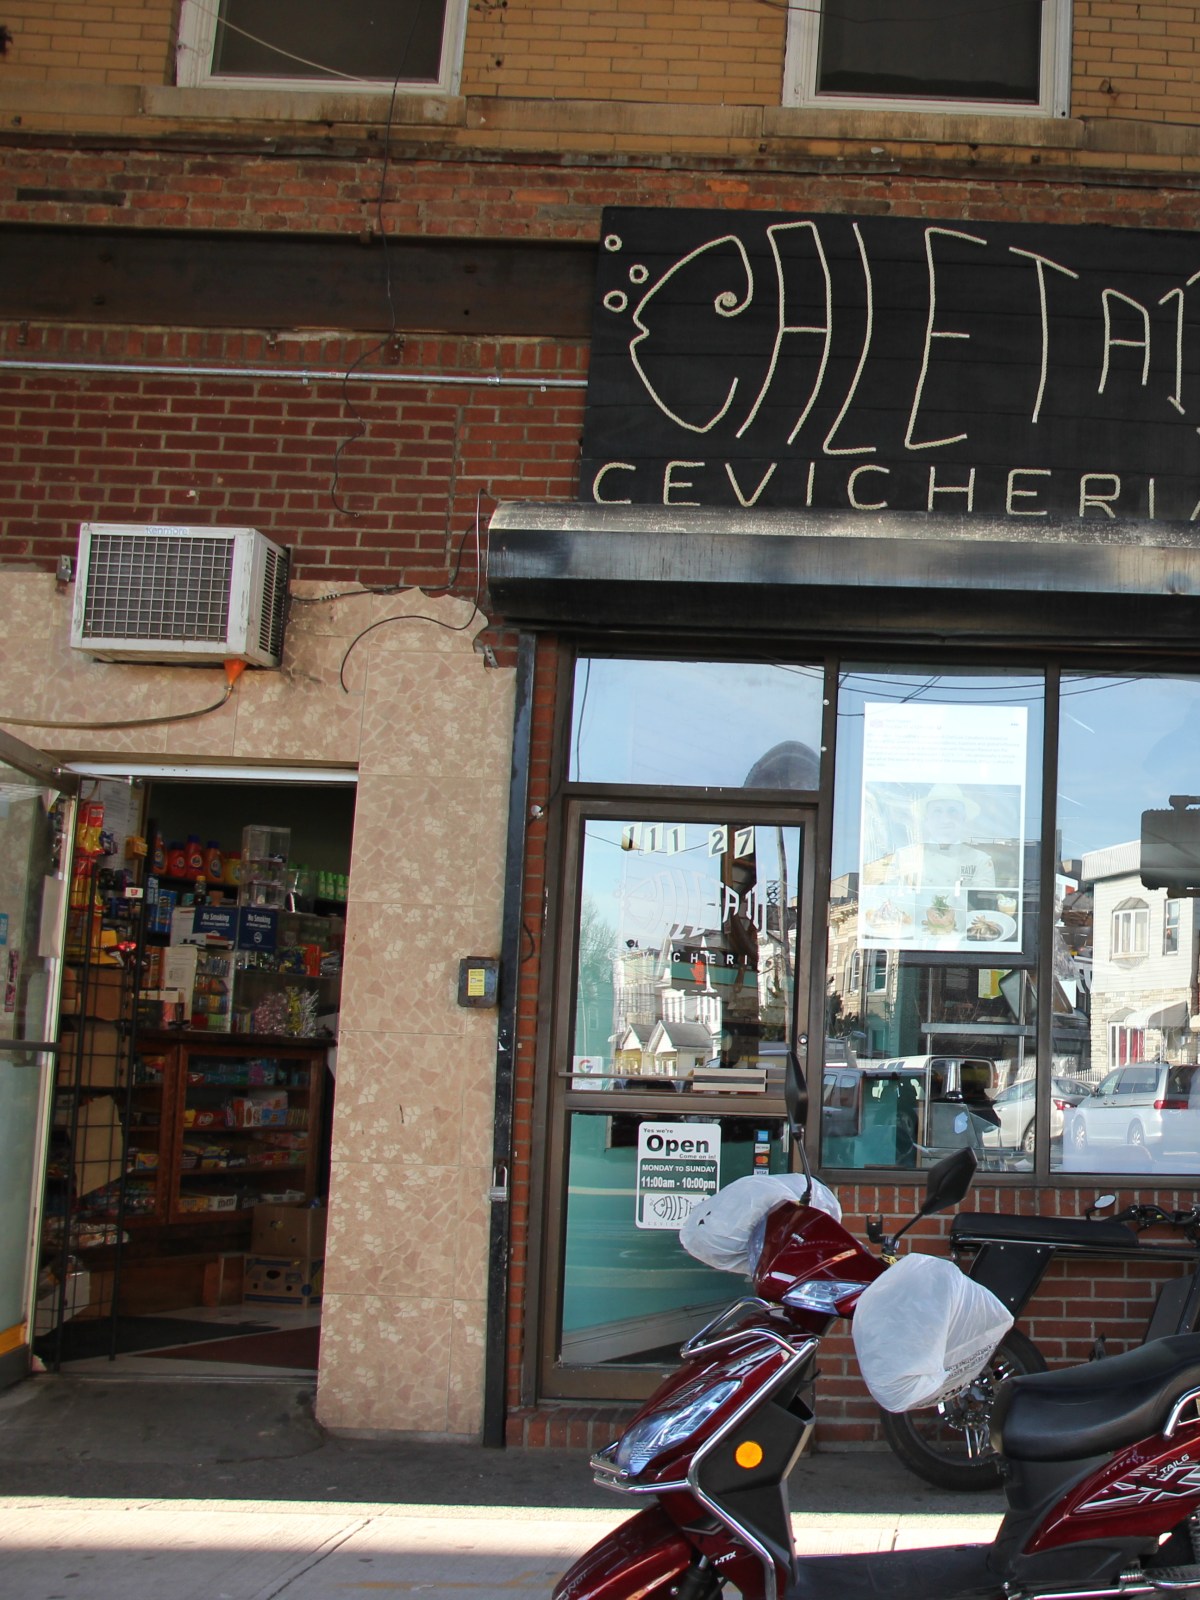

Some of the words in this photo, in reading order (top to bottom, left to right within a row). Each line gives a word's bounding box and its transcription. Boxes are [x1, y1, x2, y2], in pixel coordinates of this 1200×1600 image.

[146, 527, 188, 536] Kenmore
[629, 826, 679, 852] 111
[712, 830, 753, 855] 27
[210, 913, 230, 923] Smoking
[647, 1134, 709, 1157] Open
[642, 1164, 674, 1172] MONDAY
[685, 1165, 716, 1173] SUNDAY
[641, 1176, 675, 1188] 11:00am
[681, 1177, 716, 1191] 10:00pm
[1160, 1453, 1190, 1475] TAILG
